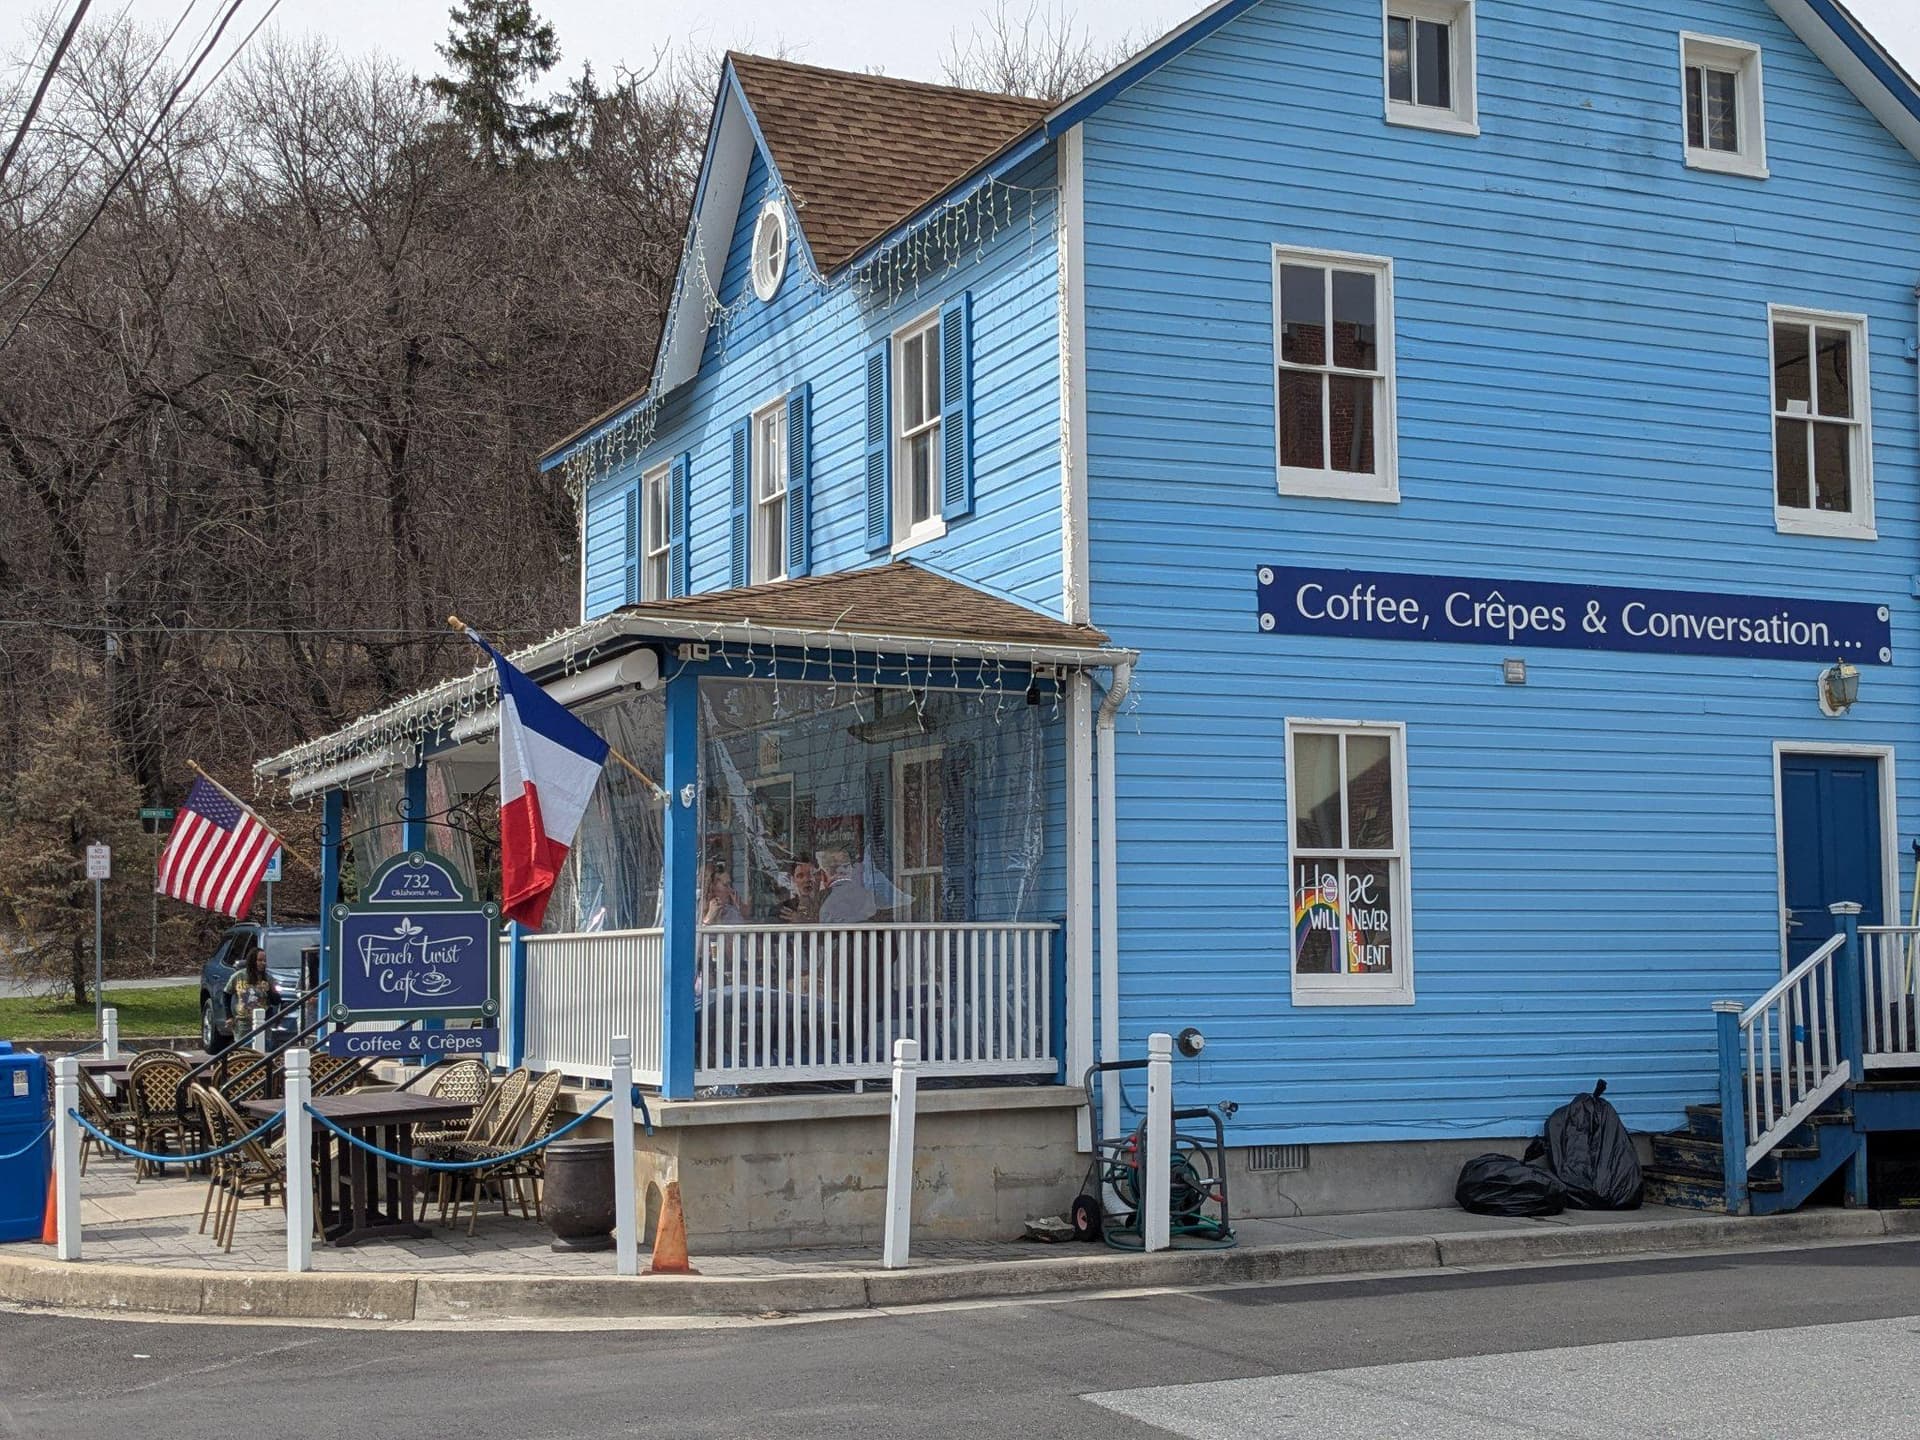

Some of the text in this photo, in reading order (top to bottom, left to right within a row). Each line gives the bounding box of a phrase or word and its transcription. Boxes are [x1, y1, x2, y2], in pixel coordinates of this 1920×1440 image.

[1296, 583, 1862, 649] Coffee, Crêpes & Conversation...
[391, 889, 442, 897] Oklahoma Ave.
[403, 874, 430, 889] 732
[1309, 907, 1389, 932] WILL NEVER
[1347, 931, 1358, 944] BE
[358, 934, 414, 978] French
[1351, 943, 1391, 967] SILENT
[379, 968, 427, 1004] Café
[347, 1033, 483, 1053] Coffee & Crêpes
